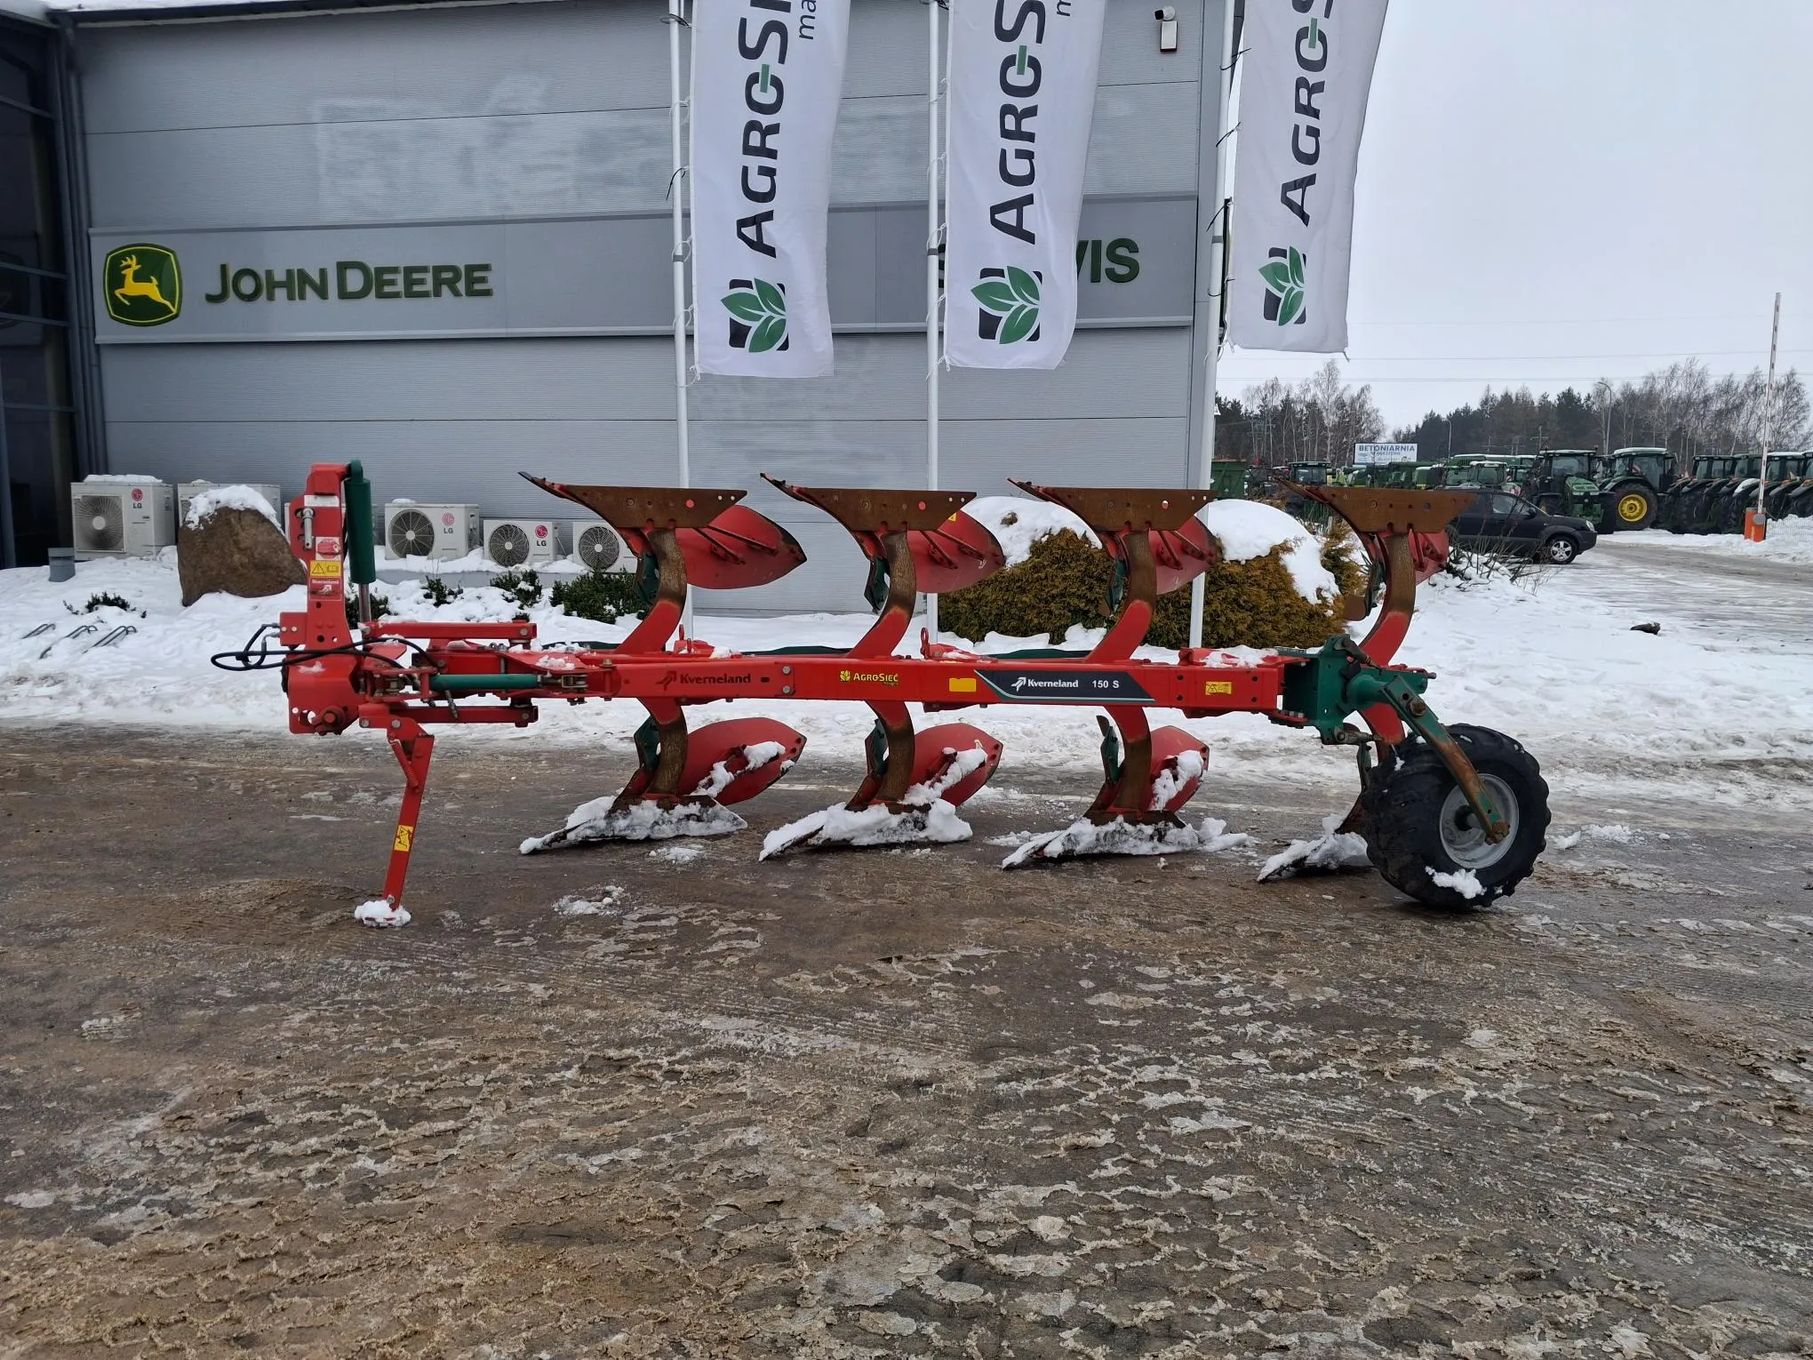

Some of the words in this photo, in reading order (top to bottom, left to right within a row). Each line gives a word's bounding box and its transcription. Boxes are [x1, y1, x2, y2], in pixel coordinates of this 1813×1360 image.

[205, 263, 329, 303] JOHN
[336, 260, 493, 300] DEERE
[1358, 444, 1415, 452] BETONIARNIA
[443, 527, 454, 535] LG
[679, 672, 751, 684] Kverneland
[1027, 678, 1079, 689] Kverneland
[1092, 680, 1109, 689] 150
[1112, 680, 1120, 689] S
